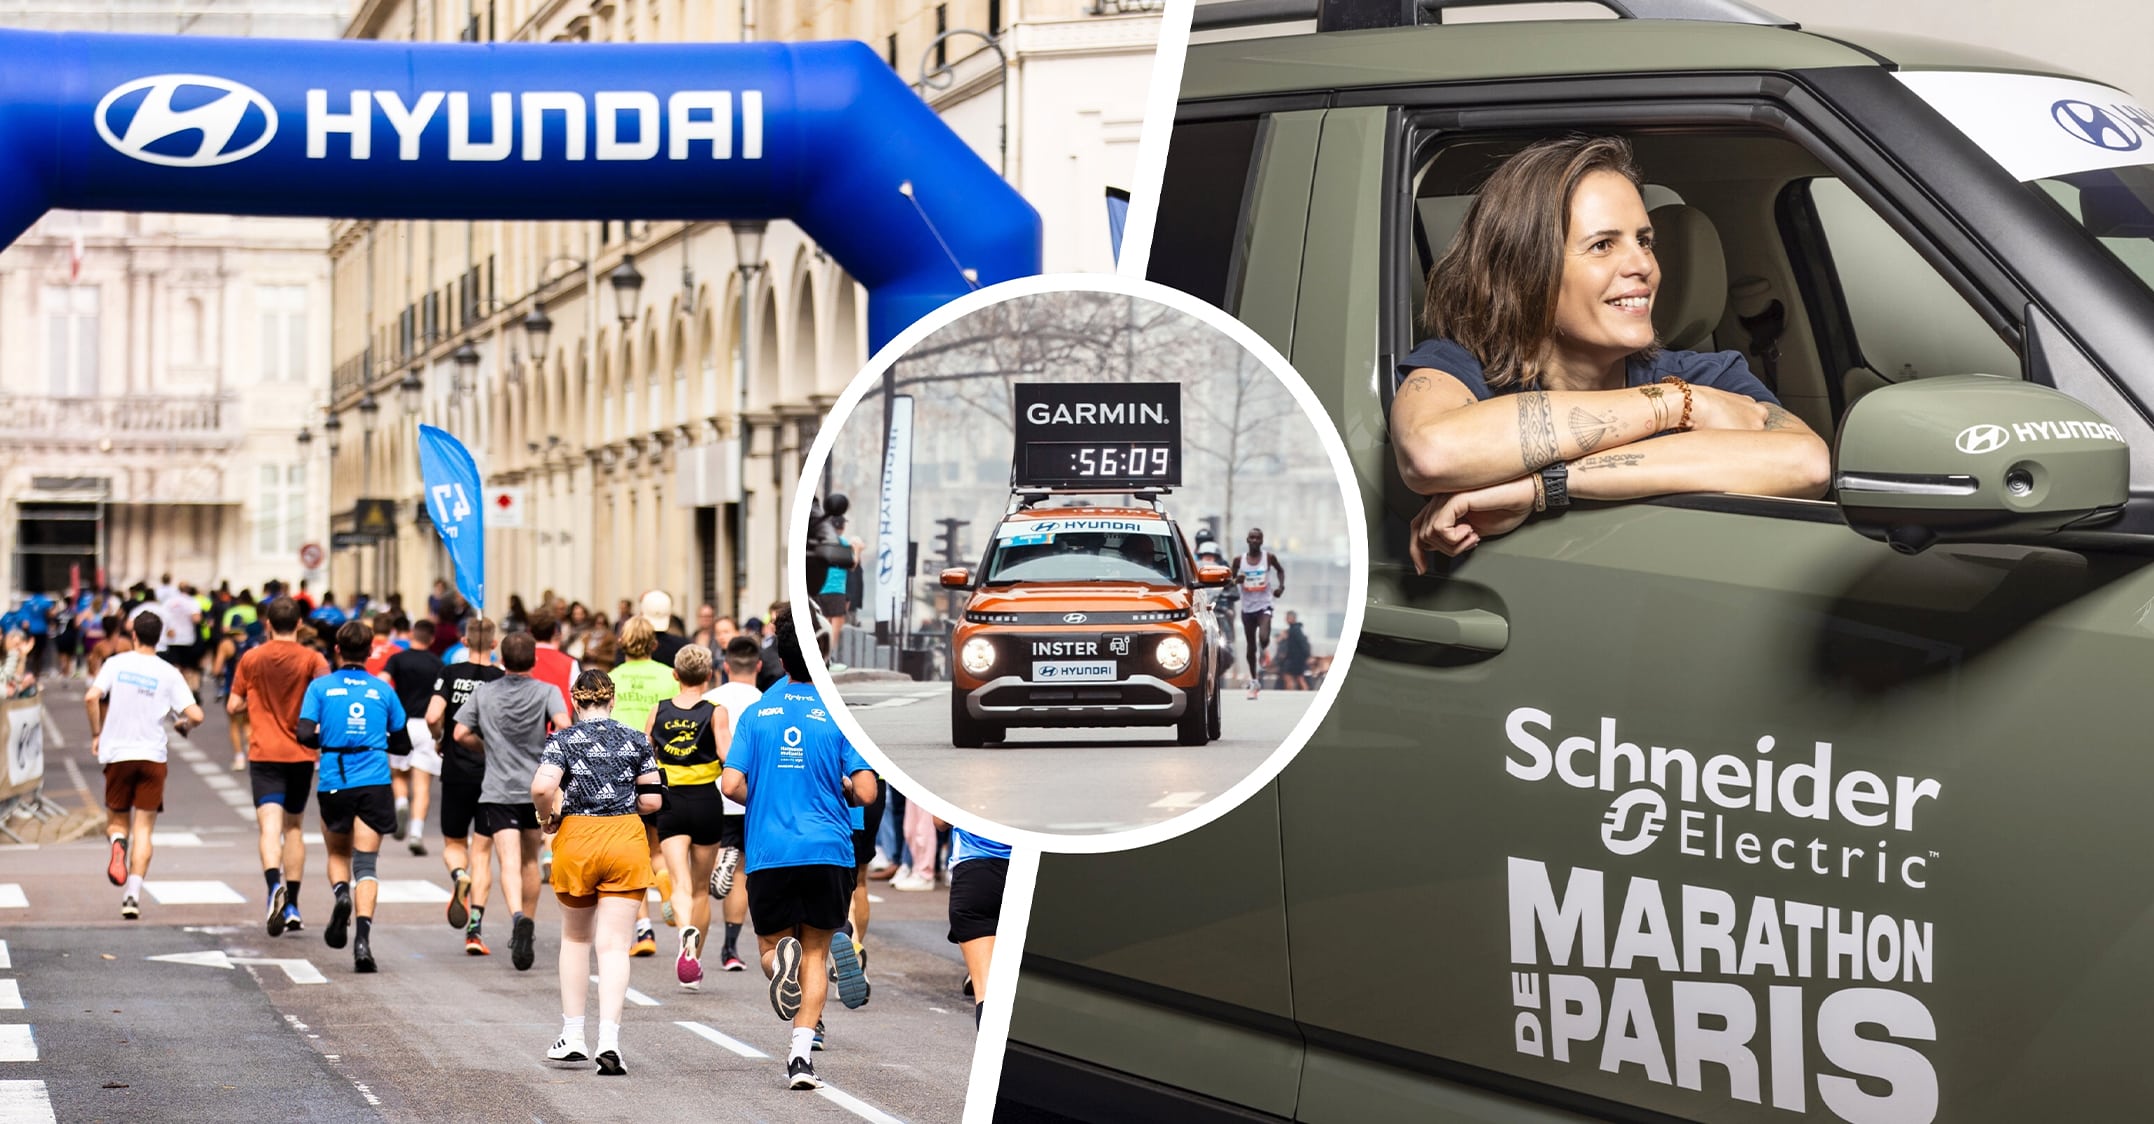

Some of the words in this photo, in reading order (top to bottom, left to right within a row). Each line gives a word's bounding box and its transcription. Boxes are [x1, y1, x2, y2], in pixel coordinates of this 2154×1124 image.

[306, 88, 763, 161] HYUNDAI
[2011, 420, 2126, 444] HYUNDAI
[1064, 521, 1141, 532] HYUNDAI
[1032, 641, 1099, 656] INSTER
[1061, 666, 1112, 675] HYUNDAI
[617, 749, 640, 757] adidas
[1505, 706, 1942, 832] Schneider
[1680, 808, 1927, 889] Electric
[1507, 856, 1935, 984] MARATHON
[1511, 971, 1545, 1058] DE
[1548, 973, 1940, 1124] PARIS
